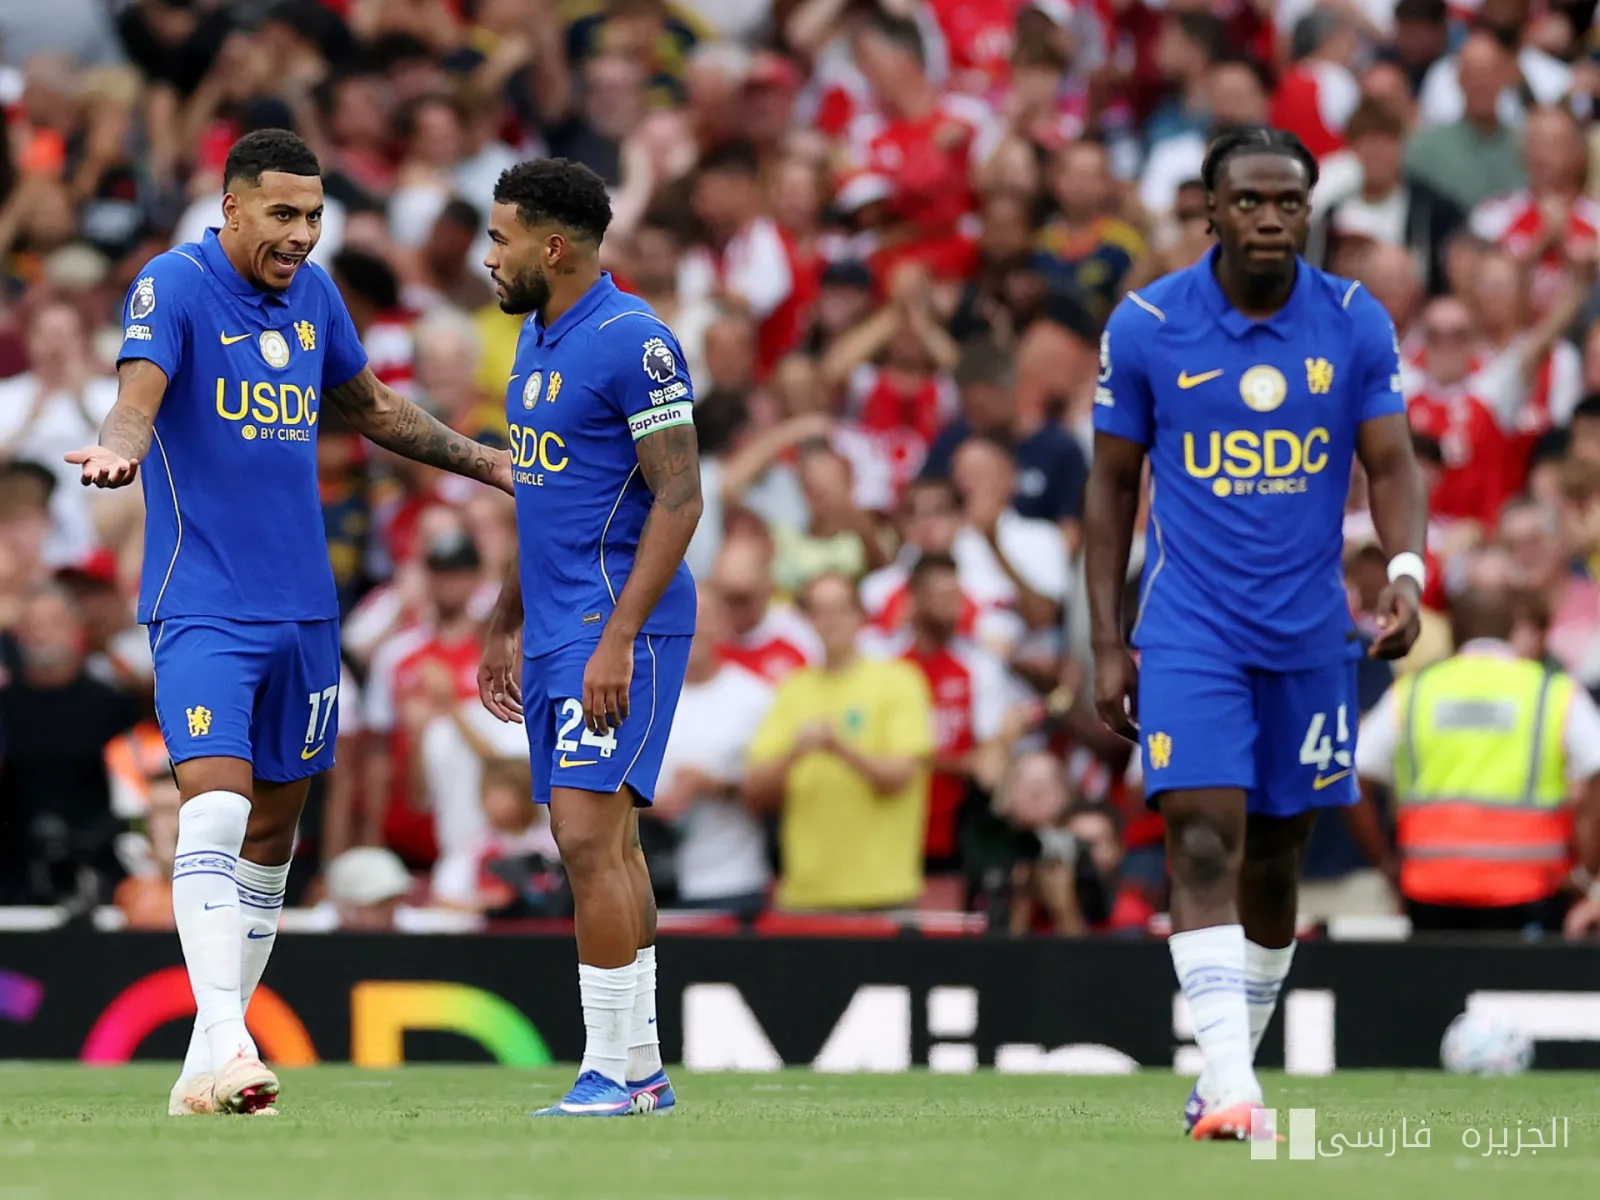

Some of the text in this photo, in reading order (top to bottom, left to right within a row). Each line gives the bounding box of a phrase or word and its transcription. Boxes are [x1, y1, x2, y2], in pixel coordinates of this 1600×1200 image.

[216, 378, 317, 427] USDC
[649, 389, 663, 400] No
[261, 427, 310, 442] BY CIRCLE
[630, 408, 681, 433] Captain
[509, 423, 569, 472] SDC
[1183, 427, 1330, 479] USDC
[1233, 479, 1255, 496] BY
[305, 684, 338, 744] 17
[555, 698, 618, 758] 24
